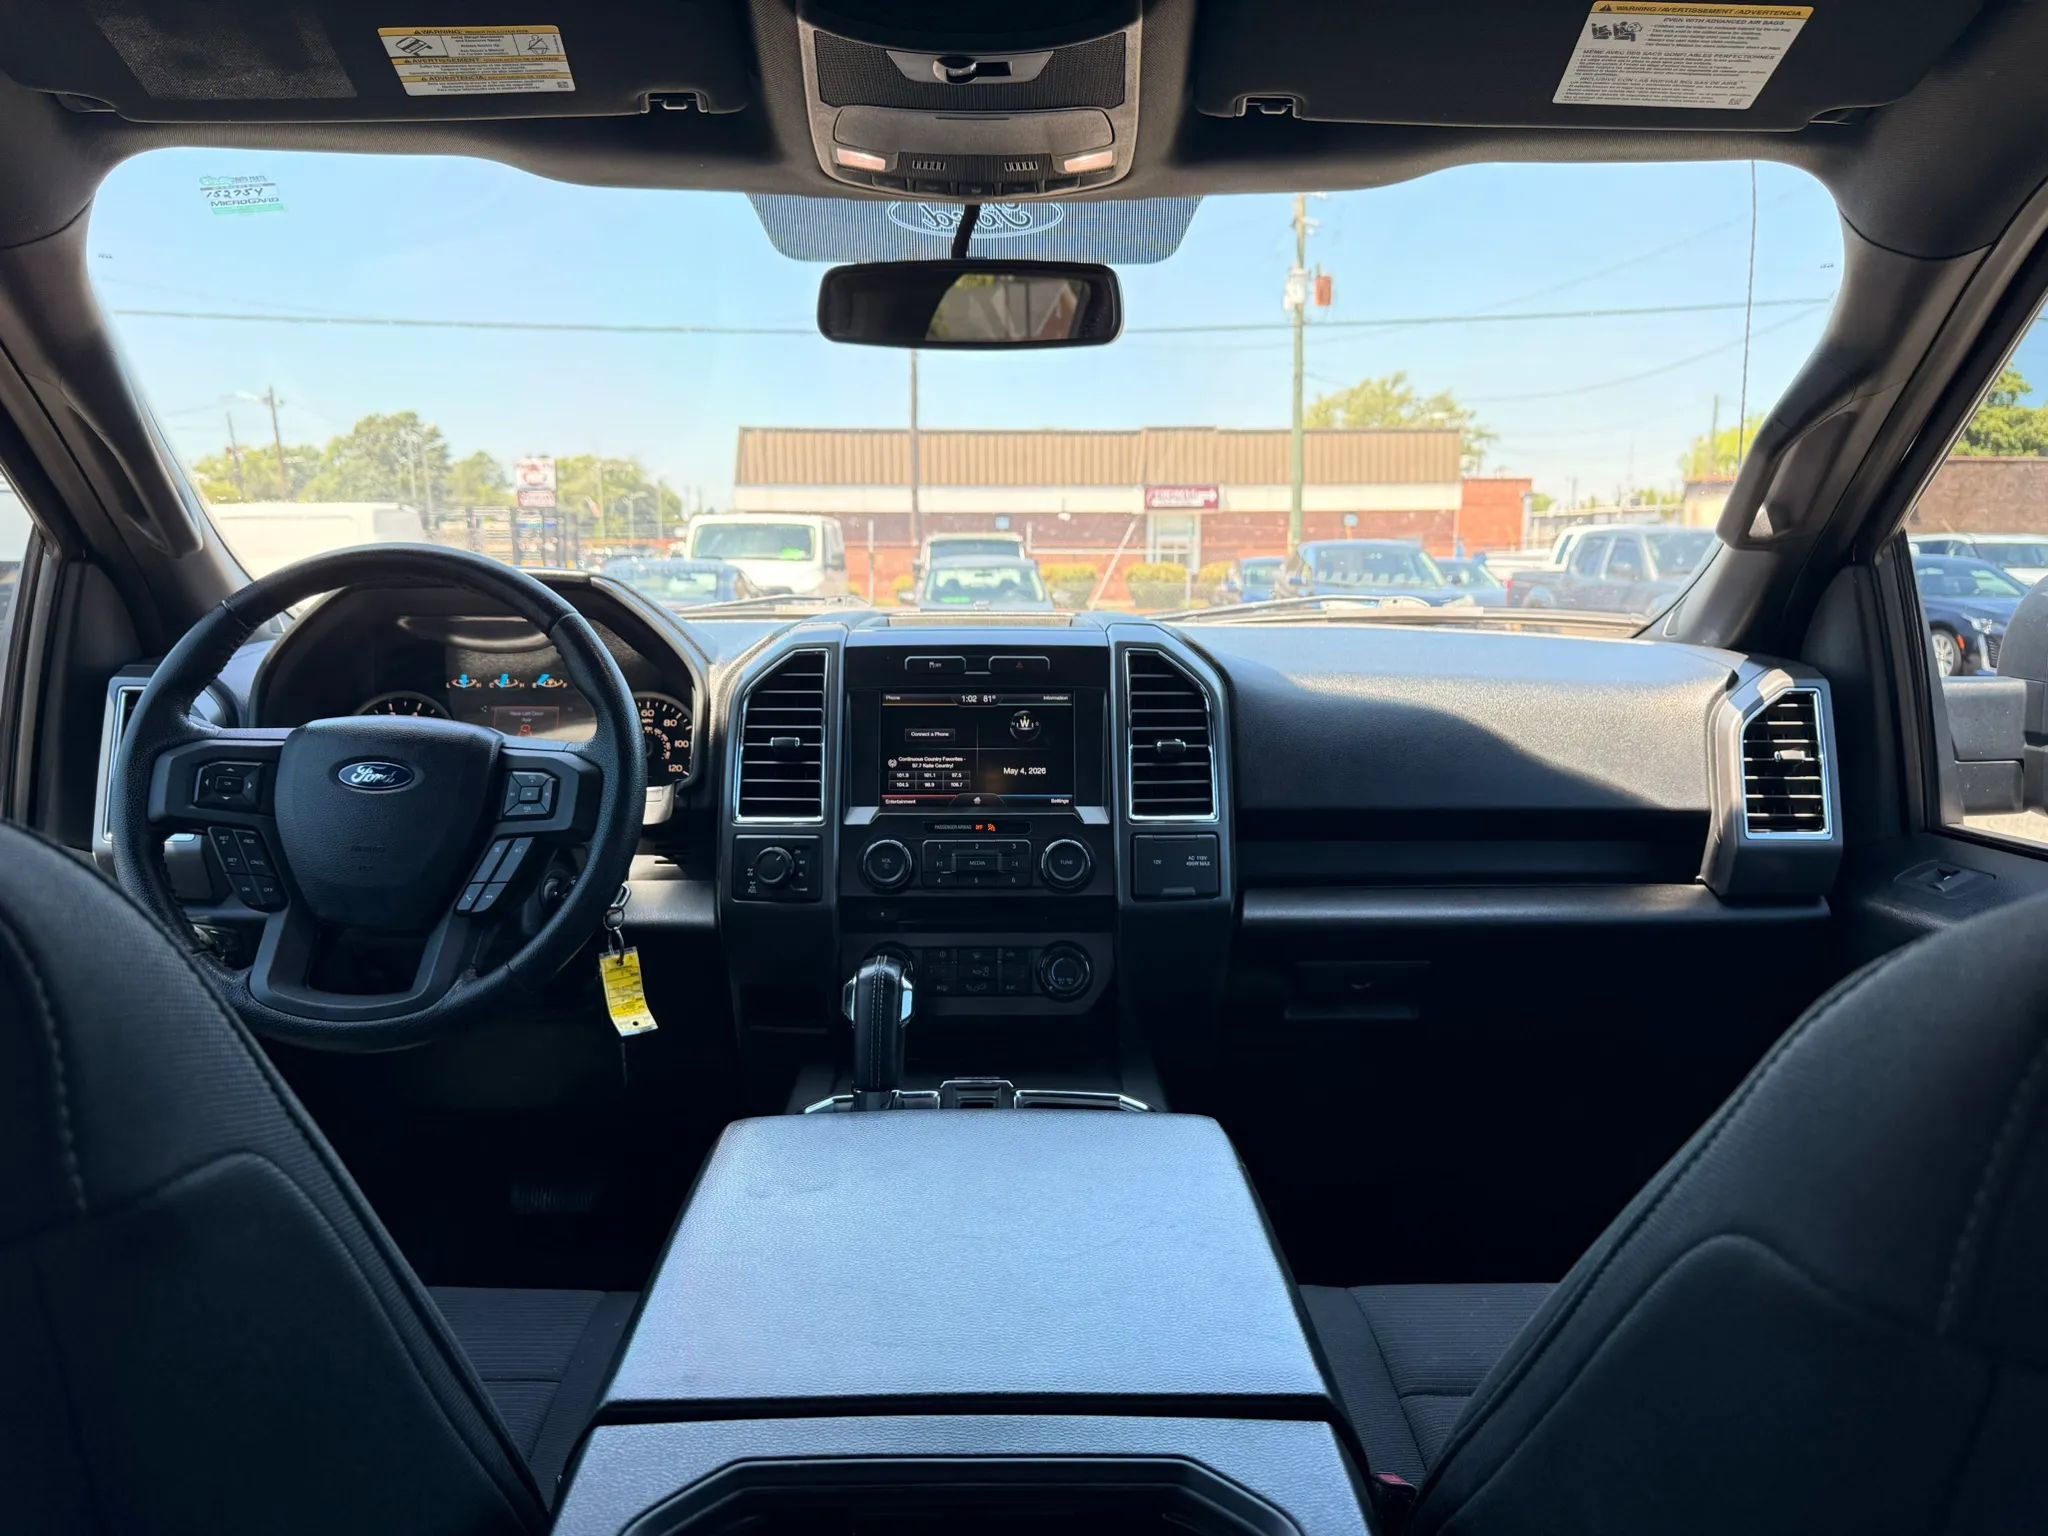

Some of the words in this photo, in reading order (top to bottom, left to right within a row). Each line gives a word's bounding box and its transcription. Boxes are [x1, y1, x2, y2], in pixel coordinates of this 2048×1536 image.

[961, 694, 978, 703] 1:02
[640, 708, 655, 717] 60
[663, 718, 678, 727] 80
[1019, 719, 1030, 729] W
[674, 740, 690, 749] 100
[667, 764, 684, 773] 120
[1003, 767, 1019, 776] May
[1019, 767, 1027, 776] 4,
[1028, 767, 1047, 775] 2026
[350, 764, 399, 784] Ford
